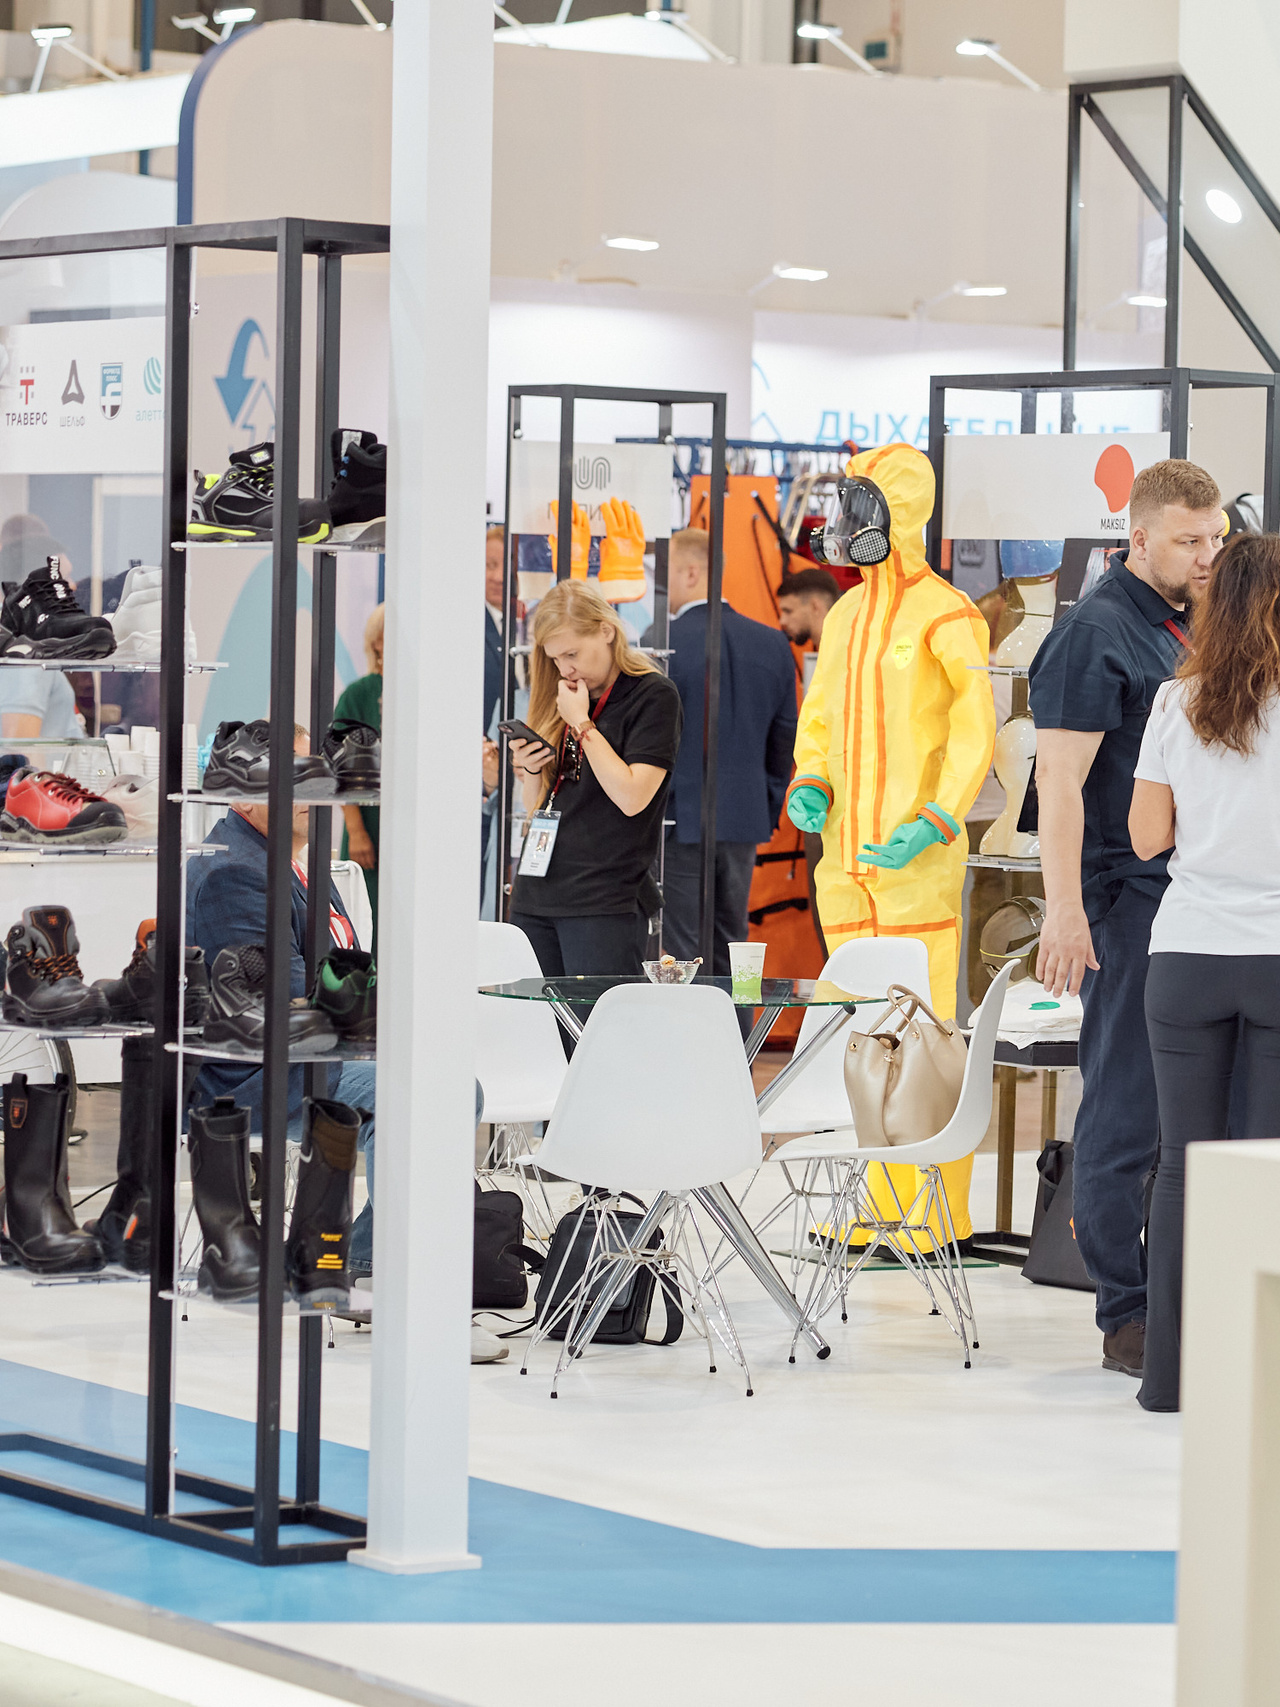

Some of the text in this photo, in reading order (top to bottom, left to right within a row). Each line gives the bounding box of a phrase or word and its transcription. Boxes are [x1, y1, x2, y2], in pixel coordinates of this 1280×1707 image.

[6, 412, 48, 426] ТРАВЕРС
[60, 416, 86, 427] ШЕЛЬФ
[136, 409, 165, 422] алетт
[1100, 518, 1126, 530] MAKSIZ
[50, 555, 60, 580] FUNC
